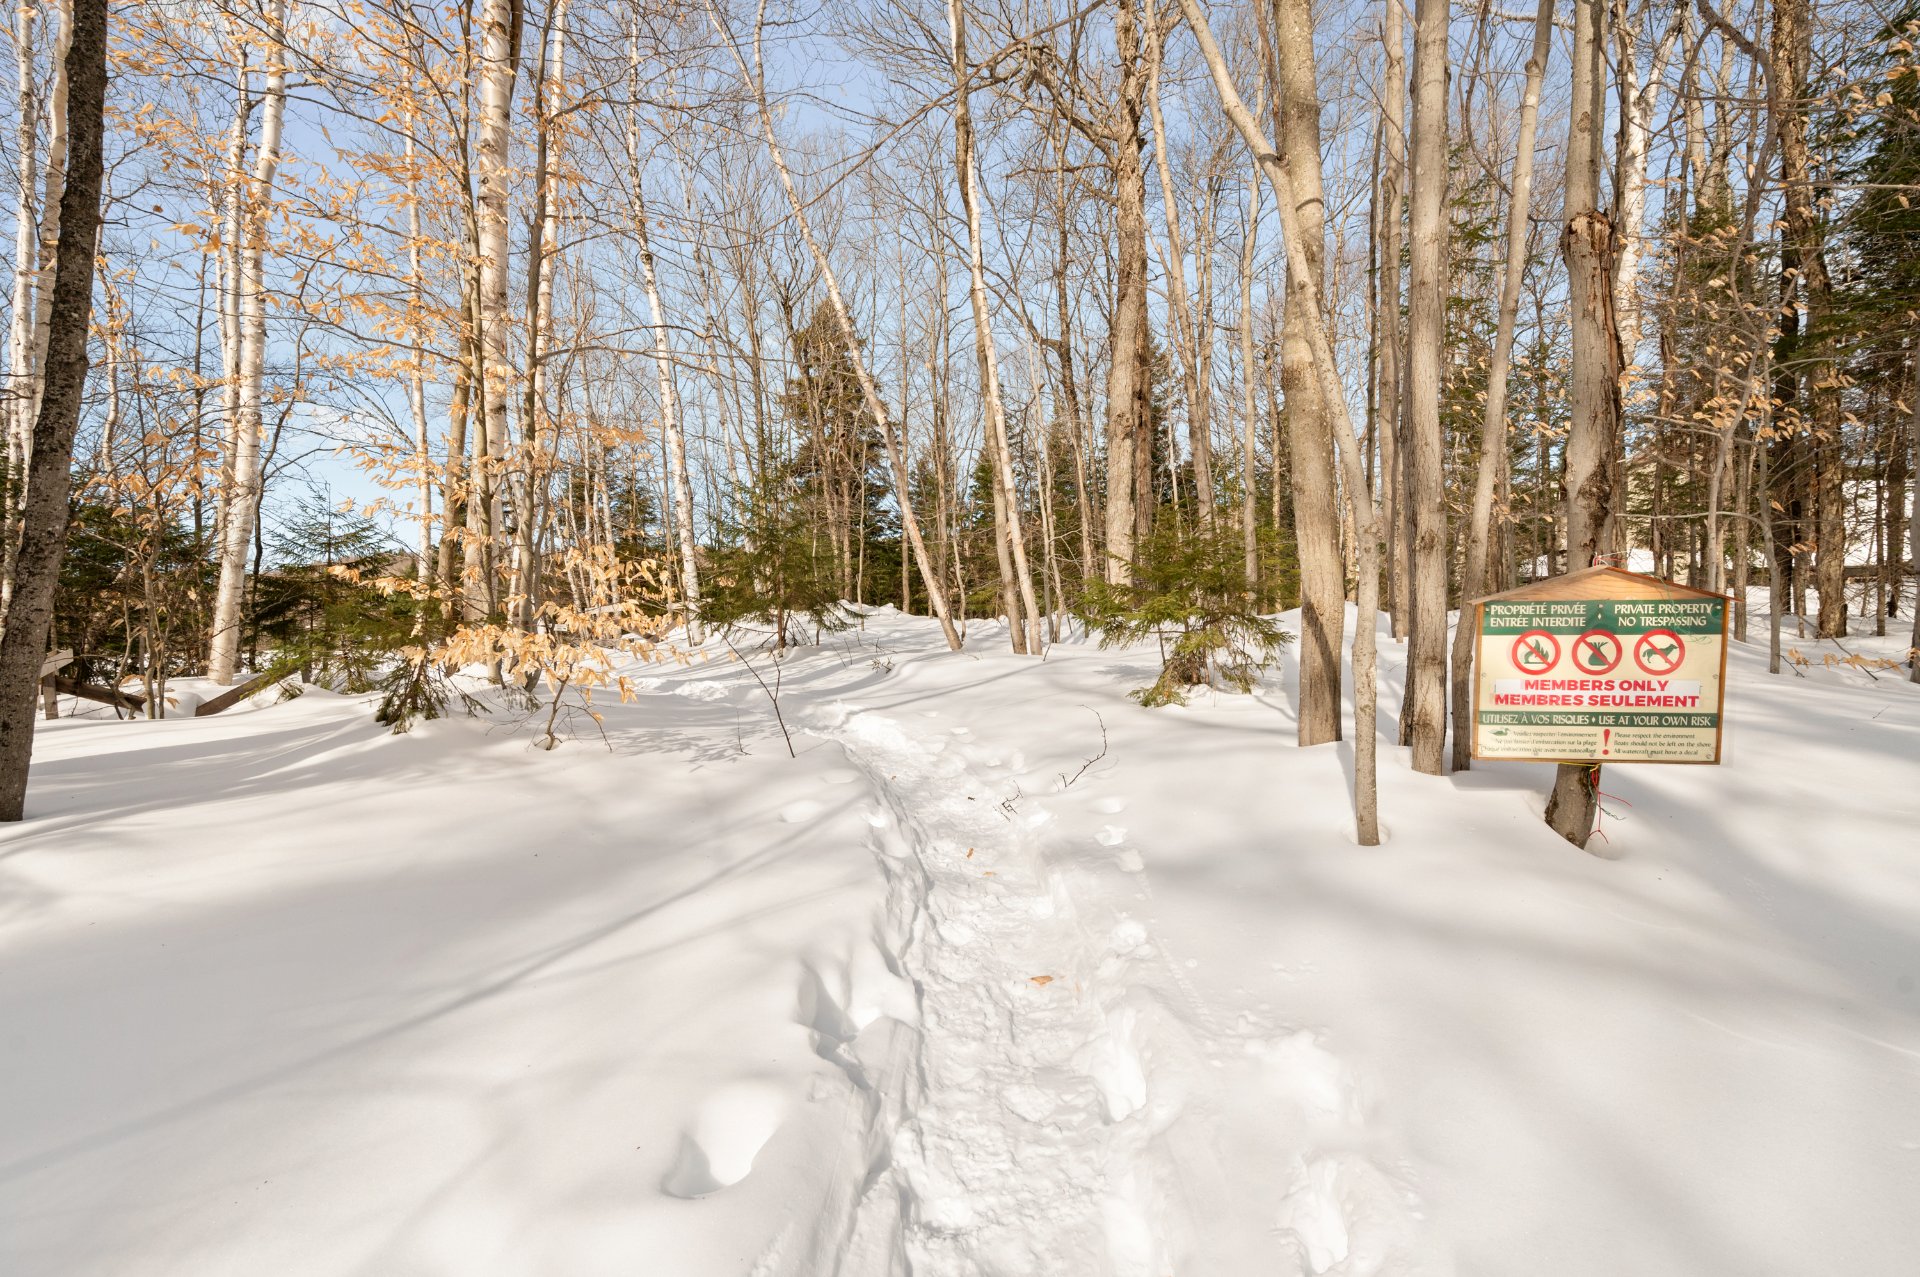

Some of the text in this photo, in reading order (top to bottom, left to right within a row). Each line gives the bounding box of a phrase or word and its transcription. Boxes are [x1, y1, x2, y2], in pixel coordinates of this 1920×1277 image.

[1490, 602, 1586, 614] PROPRIÉTÉ PRIVÉE
[1614, 604, 1712, 614] PRIVATE PROPERTY
[1490, 615, 1586, 627] ENTRÉE INTERDITE
[1618, 616, 1706, 626] NO TRESPASSING
[1524, 680, 1670, 692] MEMBERS ONLY
[1494, 694, 1699, 707] MEMBRES SEULEMENT
[1482, 712, 1711, 726] UTILISEZ À VOS RISQUES USE AT YOUR OWN RISK
